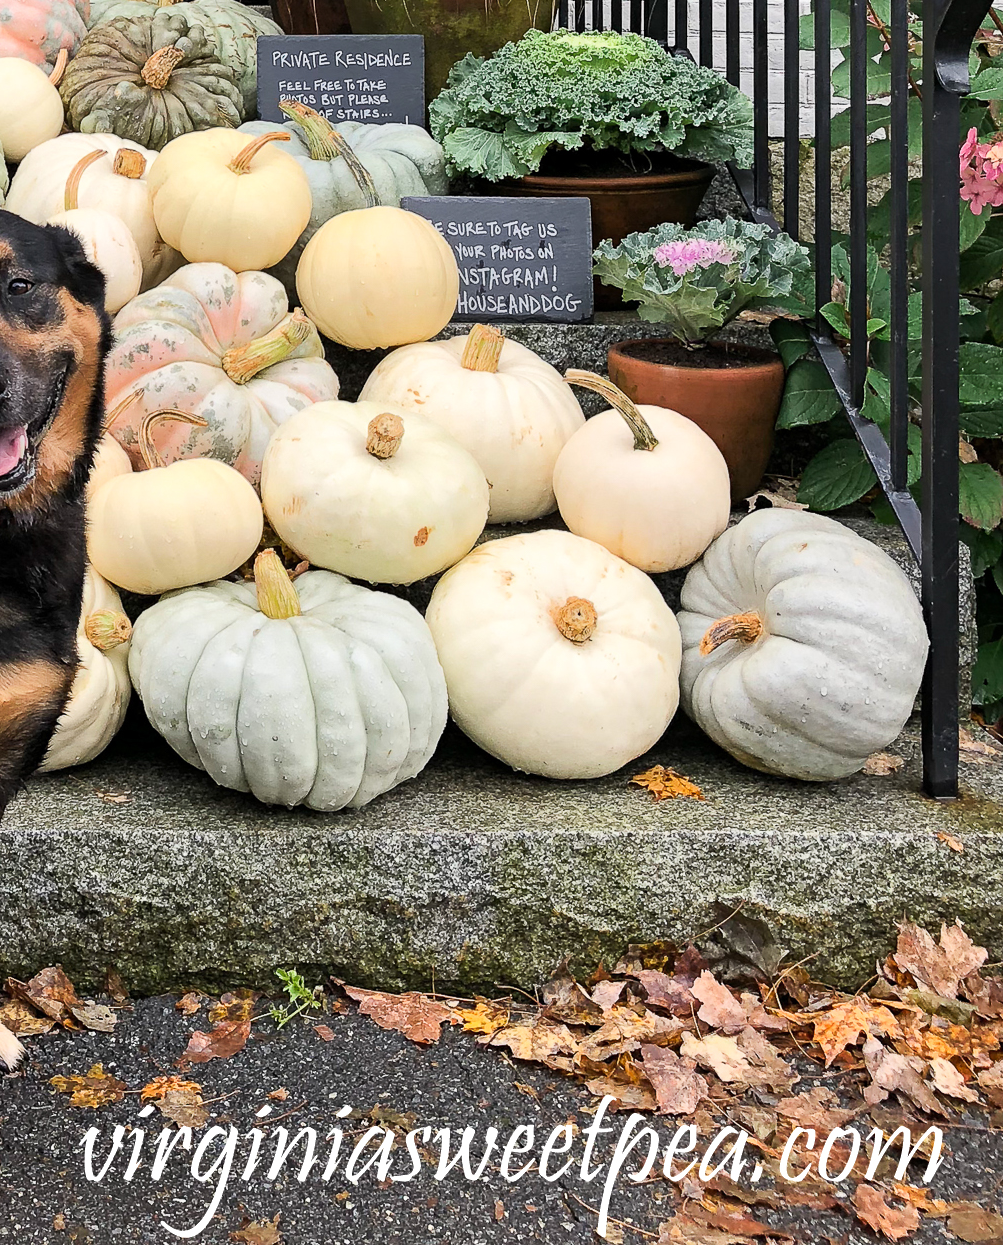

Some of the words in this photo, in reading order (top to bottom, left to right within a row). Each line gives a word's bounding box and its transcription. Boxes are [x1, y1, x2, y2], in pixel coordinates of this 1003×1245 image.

[272, 49, 331, 70] PRIVATE
[335, 48, 412, 70] RESIDENCE
[278, 80, 311, 92] FEEL
[314, 78, 343, 92] FREE
[345, 78, 356, 91] TO
[356, 78, 387, 92] TAKE
[279, 93, 317, 105] PHOTOS
[321, 94, 345, 107] BUT
[348, 94, 389, 107] PLEASE
[336, 108, 393, 120] STAIRS...
[428, 220, 445, 236] E
[447, 221, 487, 237] SURE
[486, 221, 502, 237] TO
[503, 220, 534, 239] TAG
[537, 223, 558, 239] US
[455, 242, 486, 261] YOUR
[490, 244, 535, 262] PHOTOS
[538, 242, 554, 259] ON
[458, 265, 558, 293] NSTAGRAM!
[457, 290, 582, 315] HOUSEANDDOG
